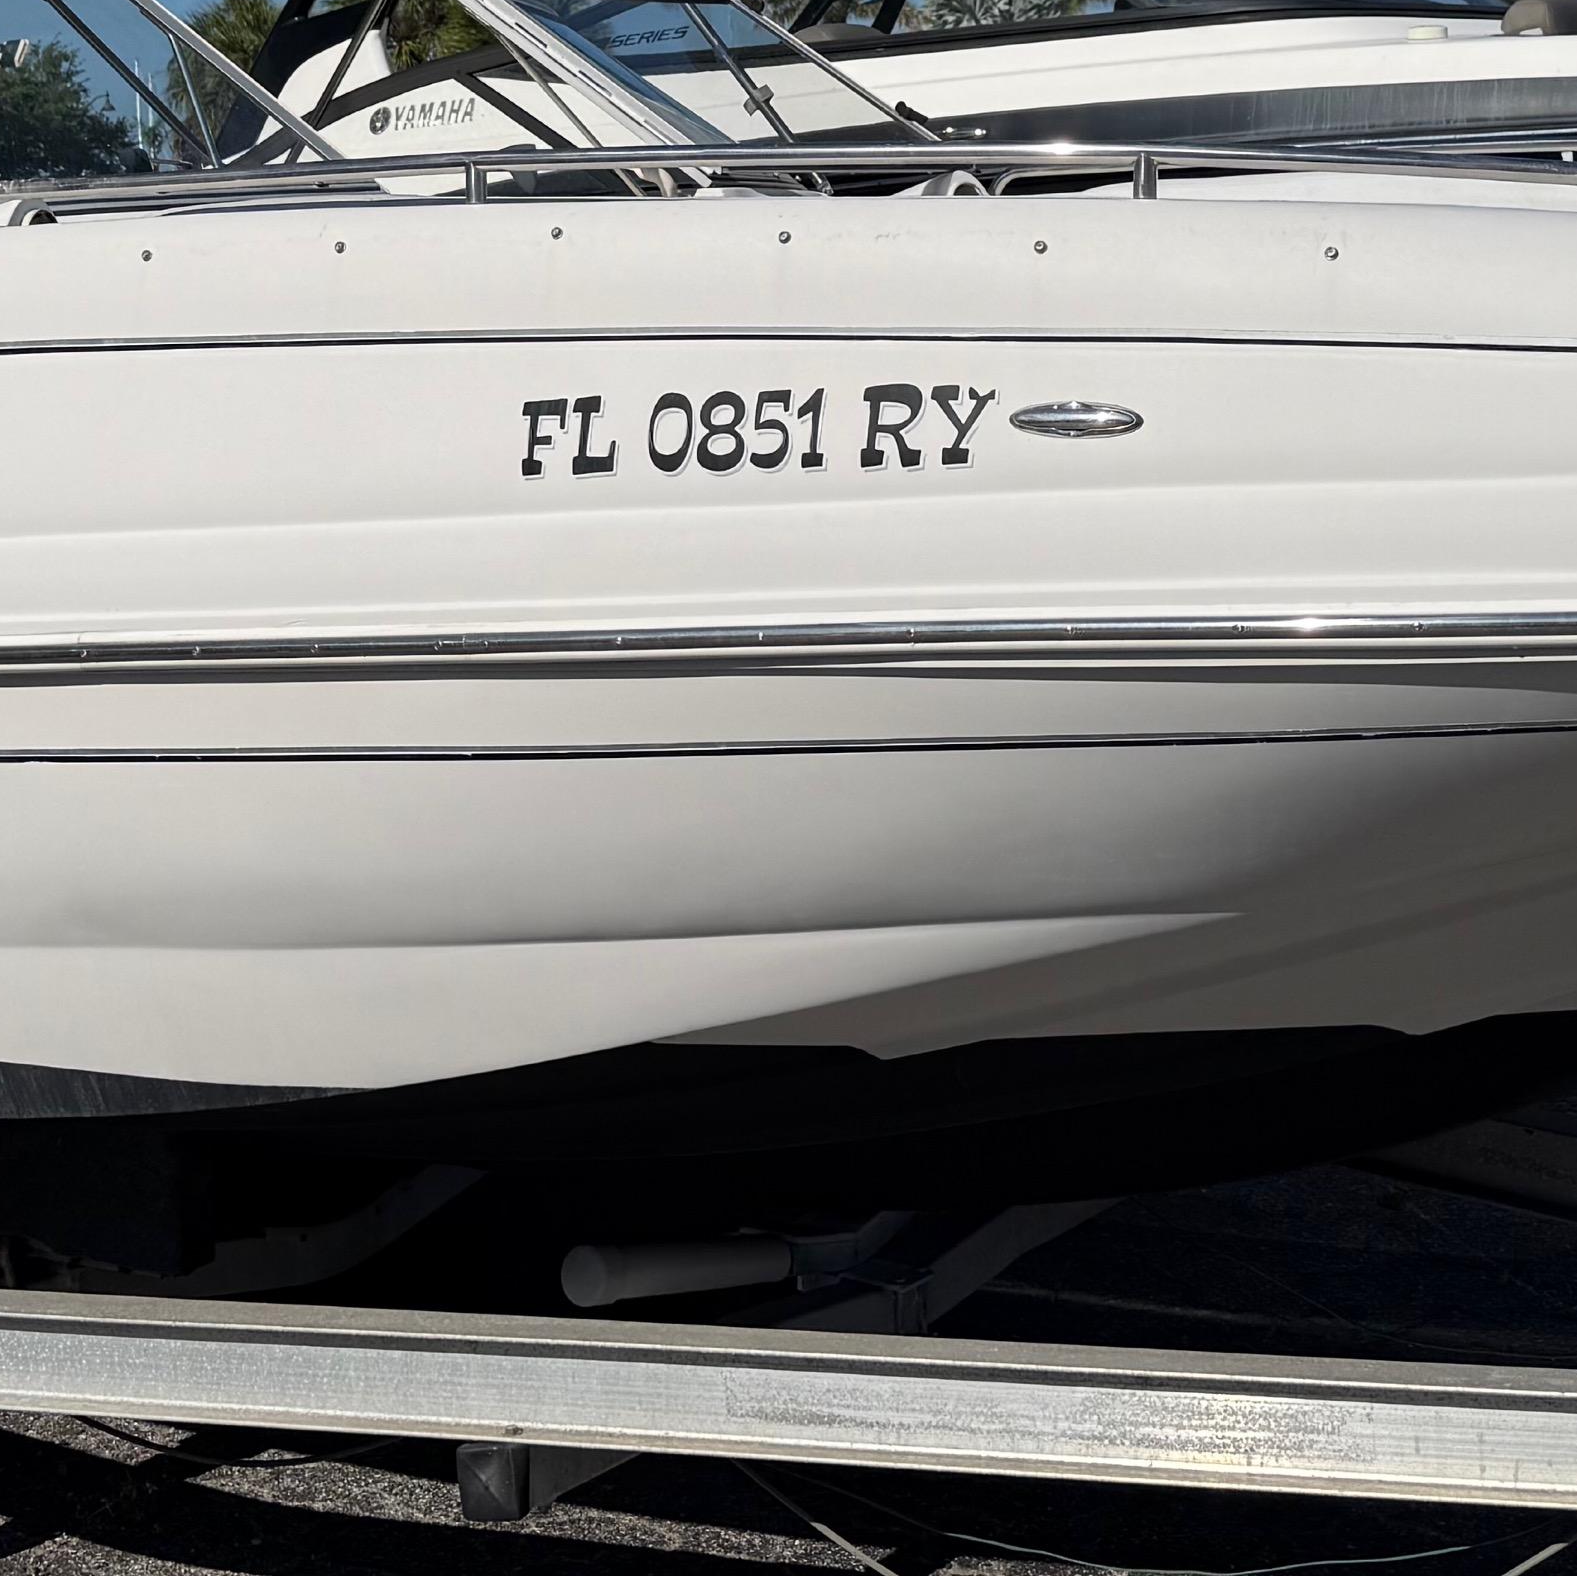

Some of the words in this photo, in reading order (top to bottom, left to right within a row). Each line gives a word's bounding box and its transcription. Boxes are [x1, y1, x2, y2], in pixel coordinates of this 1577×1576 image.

[608, 26, 690, 48] SERIES
[394, 97, 475, 131] YAMAHA
[522, 395, 618, 477] FL
[648, 388, 828, 473] 0851
[860, 382, 999, 470] RY
